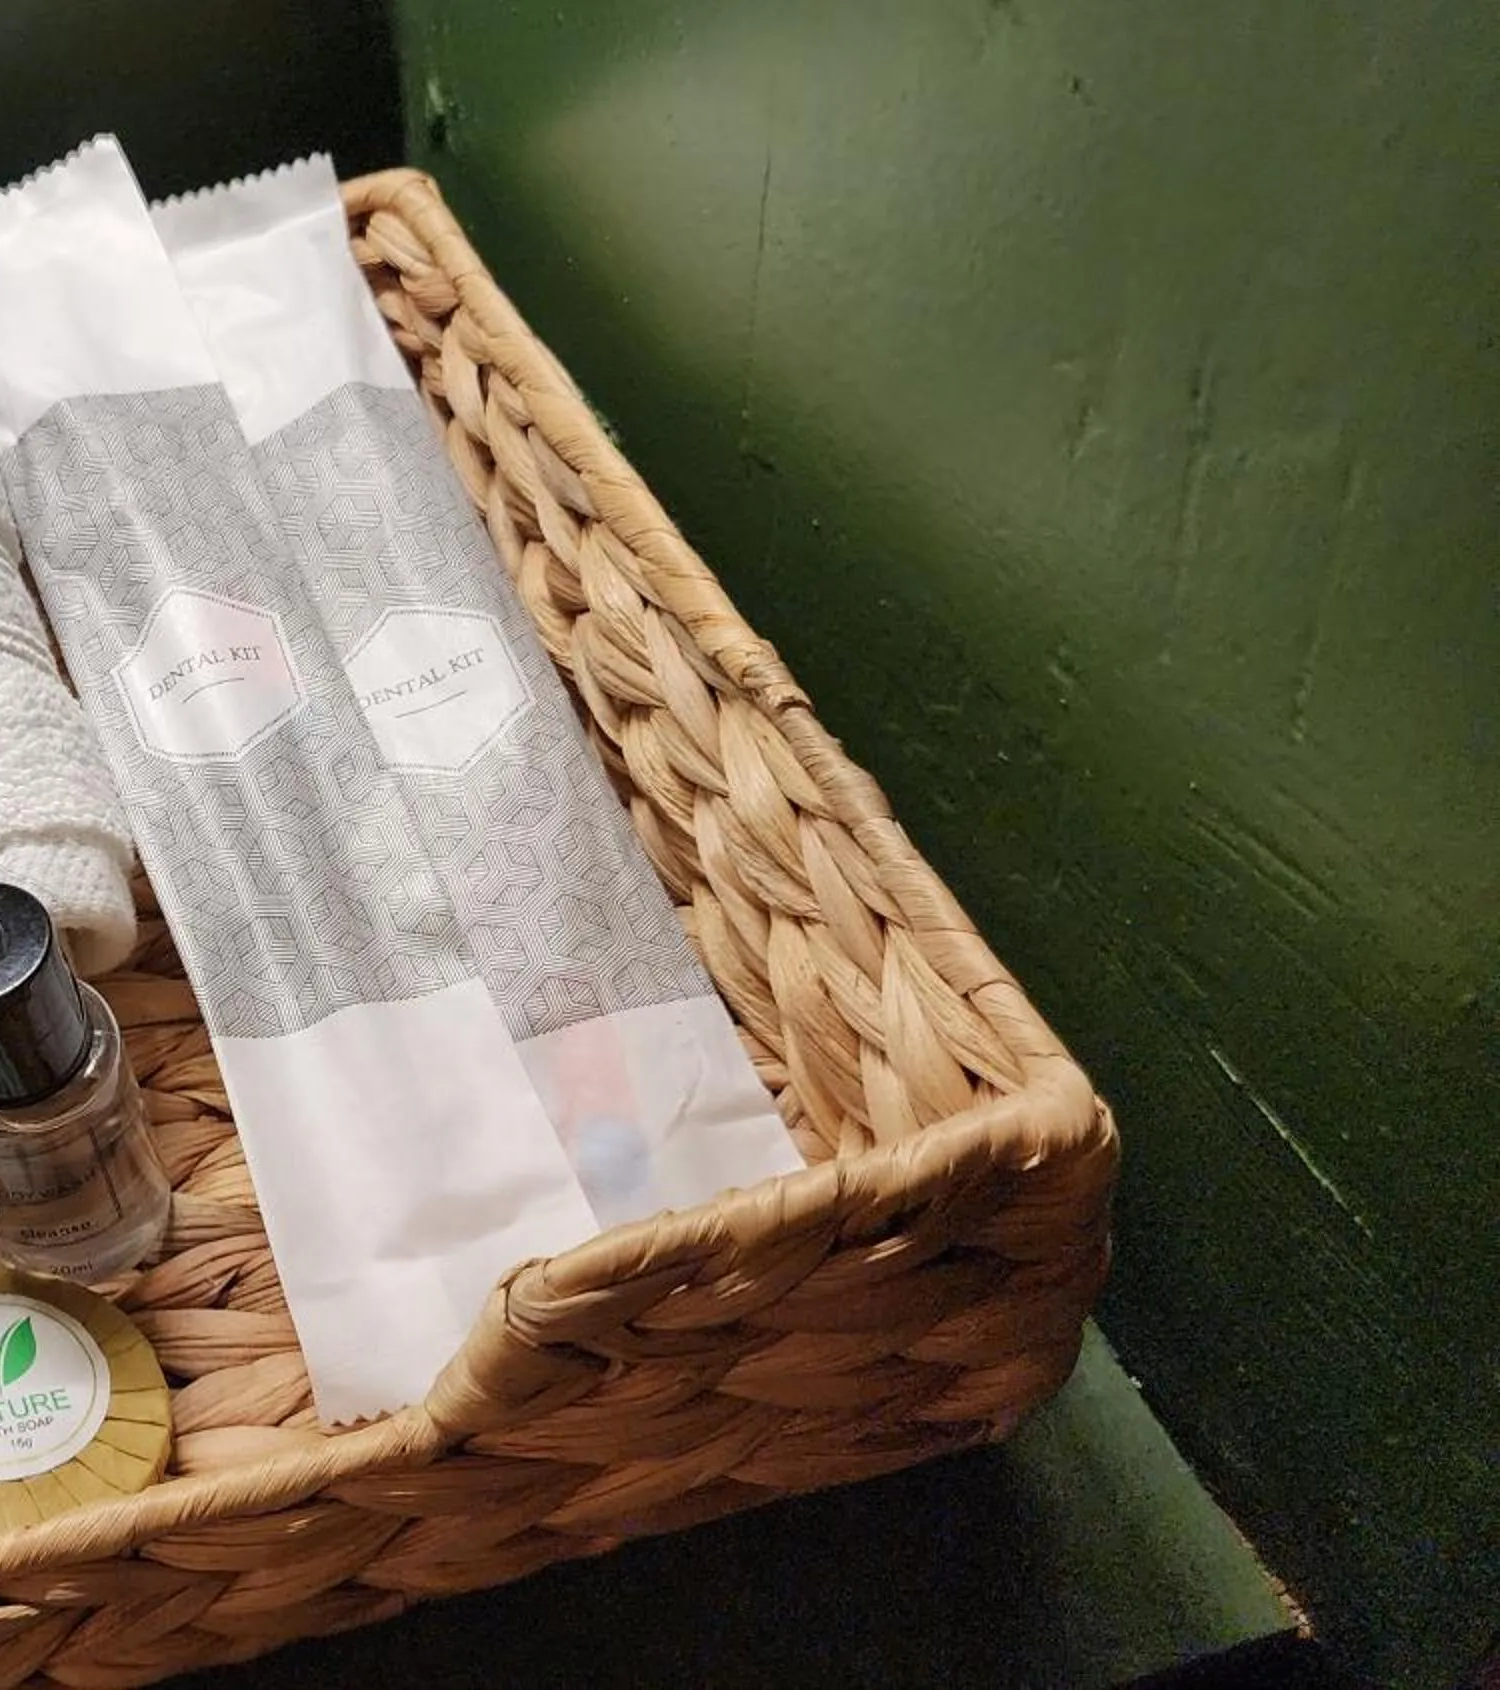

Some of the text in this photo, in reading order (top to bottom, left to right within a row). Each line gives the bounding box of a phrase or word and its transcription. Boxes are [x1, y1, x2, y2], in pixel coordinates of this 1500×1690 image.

[149, 645, 261, 700] DENTAL KIT
[447, 648, 484, 673] KIT
[16, 1416, 55, 1434] SOAP
